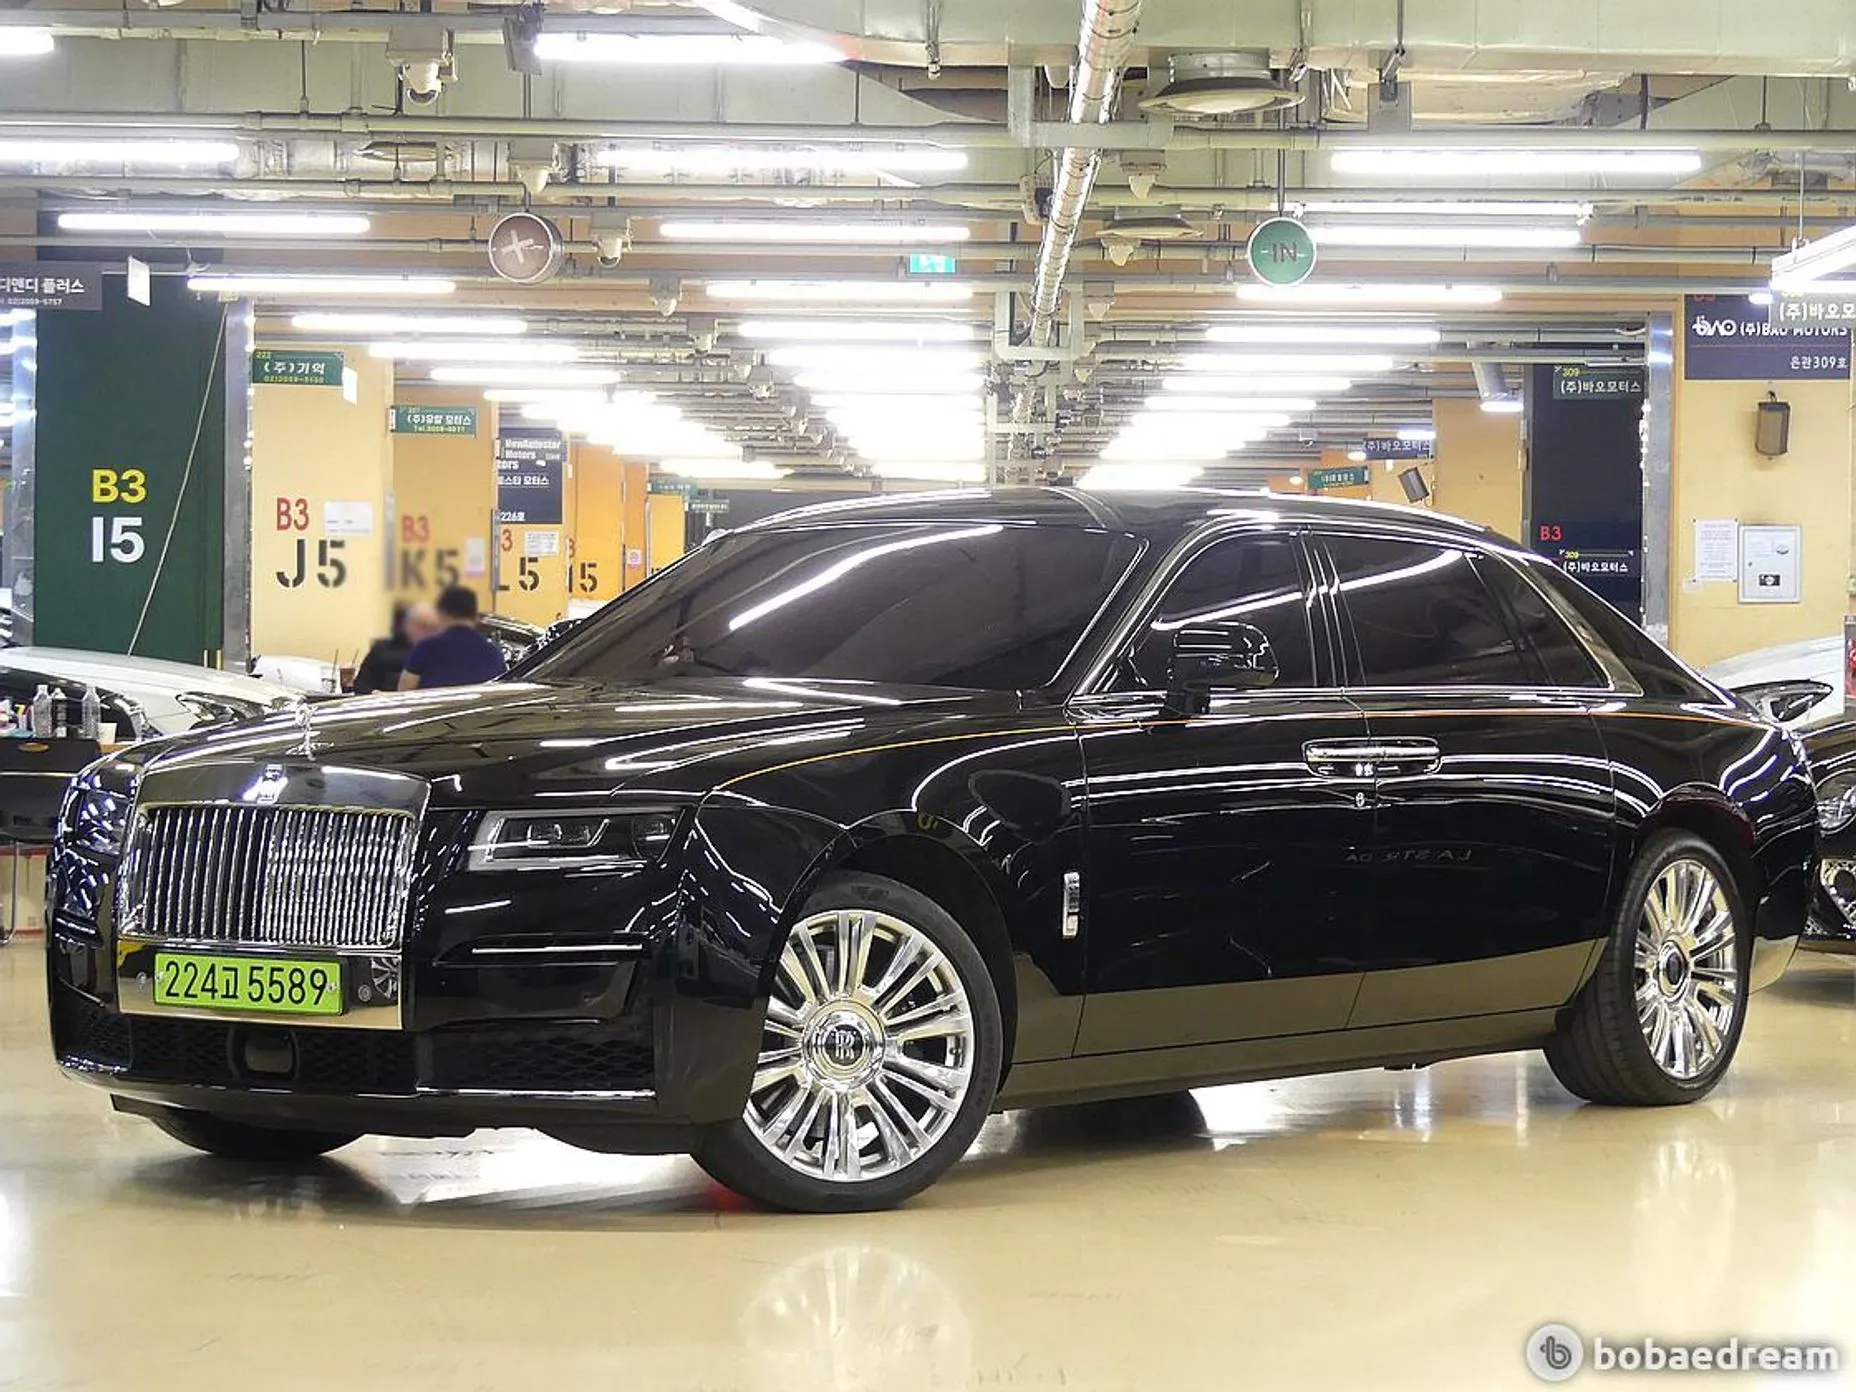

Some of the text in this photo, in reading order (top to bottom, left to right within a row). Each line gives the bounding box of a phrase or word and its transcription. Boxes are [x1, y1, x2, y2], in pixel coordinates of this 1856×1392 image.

[1272, 242, 1297, 263] IN
[43, 278, 85, 294] 플러스
[1780, 302, 1856, 322] (주)바오모
[1562, 367, 1580, 378] 309
[1560, 380, 1642, 395] (주)바오모터스
[93, 468, 147, 504] B3
[276, 497, 310, 532] B3
[1540, 525, 1563, 541] B3
[247, 965, 328, 1006] 5589
